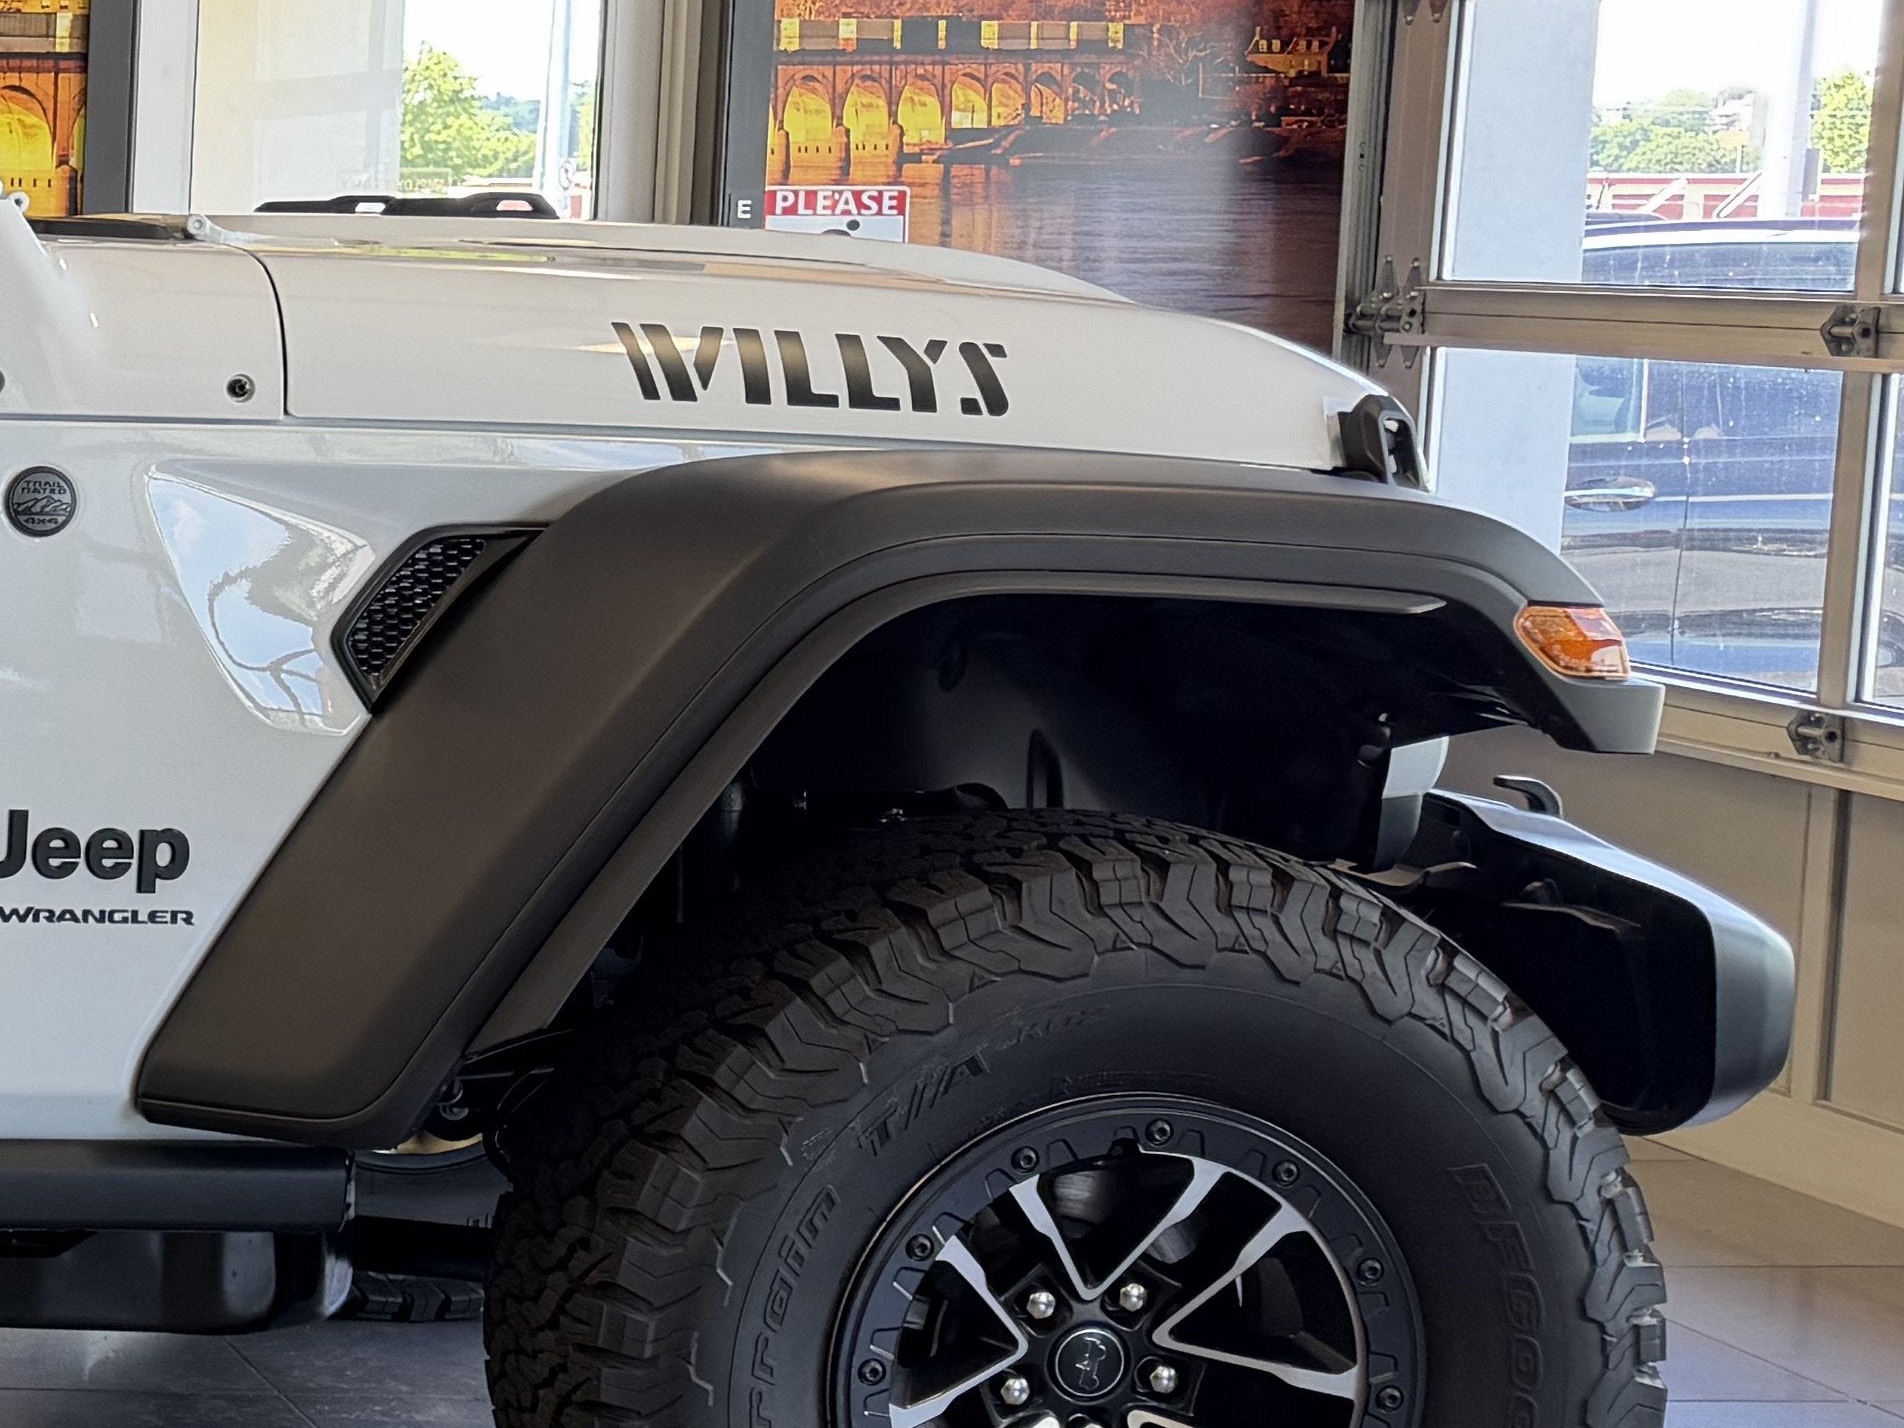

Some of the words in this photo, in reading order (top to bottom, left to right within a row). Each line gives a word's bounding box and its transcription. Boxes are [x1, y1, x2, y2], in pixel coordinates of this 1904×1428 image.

[735, 199, 752, 220] E
[773, 186, 901, 218] PLEASE
[610, 321, 1010, 418] WILLYS
